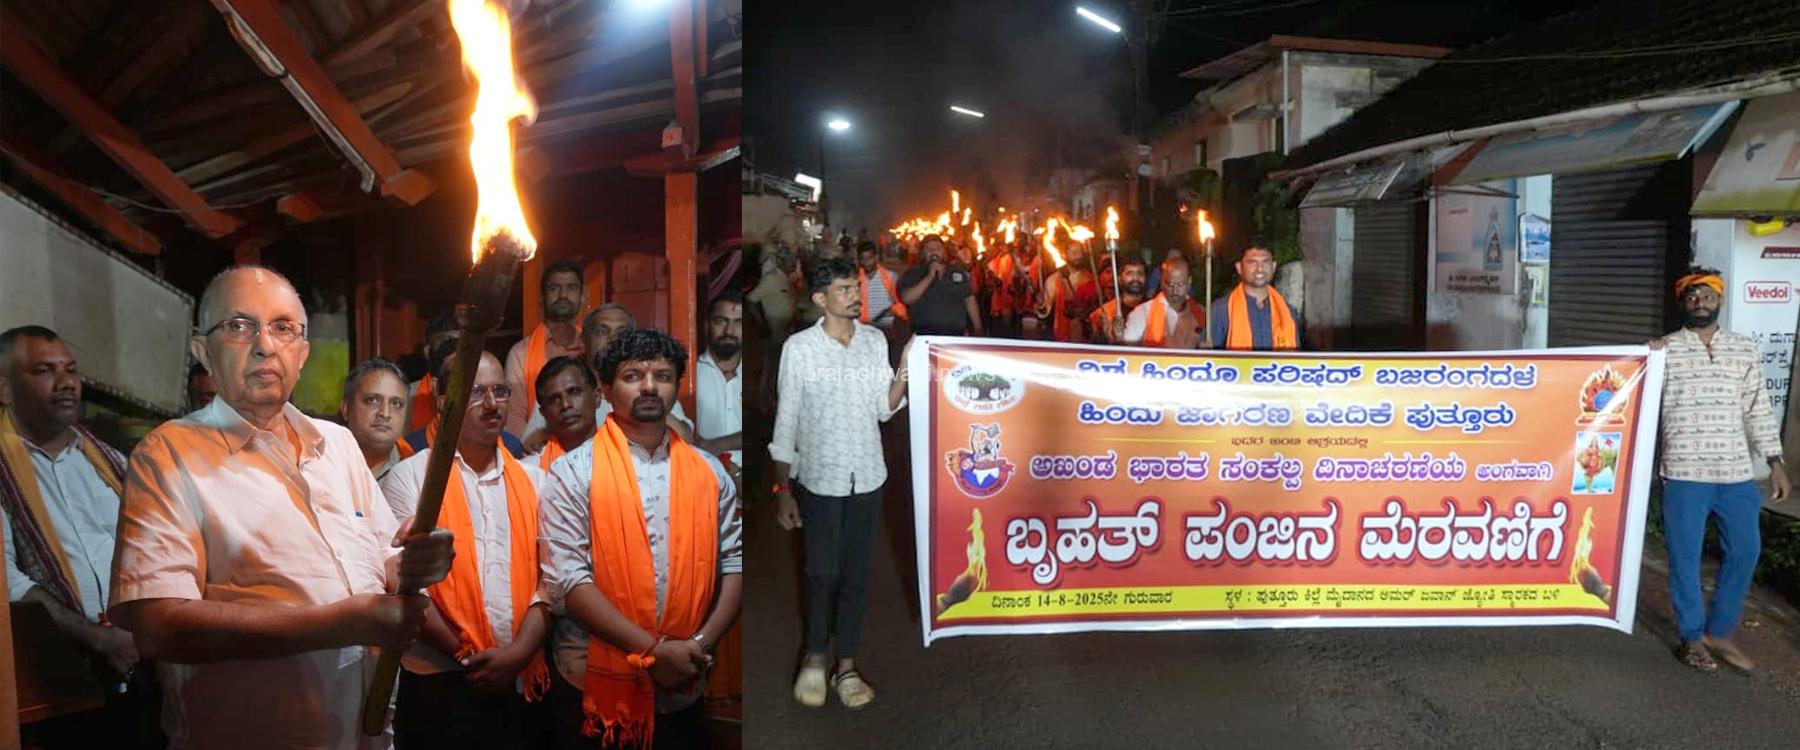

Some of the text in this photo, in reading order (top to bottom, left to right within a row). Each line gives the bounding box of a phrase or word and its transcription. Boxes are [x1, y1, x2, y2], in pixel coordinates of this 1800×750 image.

[1748, 286, 1788, 298] Veedol
[1252, 363, 1361, 387] ಪರಿಷದ್
[1376, 364, 1537, 388] ಬಜರಂಗದಳ
[1080, 402, 1162, 424] ಹಿಂದು
[1305, 403, 1394, 425] ವೇದಿಕೆ
[1406, 404, 1516, 431] ಪುತ್ತೂರು
[1031, 452, 1553, 489] ಅಖಂಡ ಭಾರತ ಸಂಕಲ್ಪ ದಿನಾಚರಣೆಯ ಅಂಗವಾಗಿ
[1005, 500, 1568, 585] ಬೃಹತ್ ಪಂಜಿನ ಮೆರವಣಿಗೆ
[991, 594, 1032, 609] ದಿನಾಂಕ
[1123, 591, 1173, 605] ಗುರುವಾರ
[1256, 589, 1298, 607] ಪುತ್ತೂರು
[1326, 588, 1375, 607] ಮೈದಾನದ
